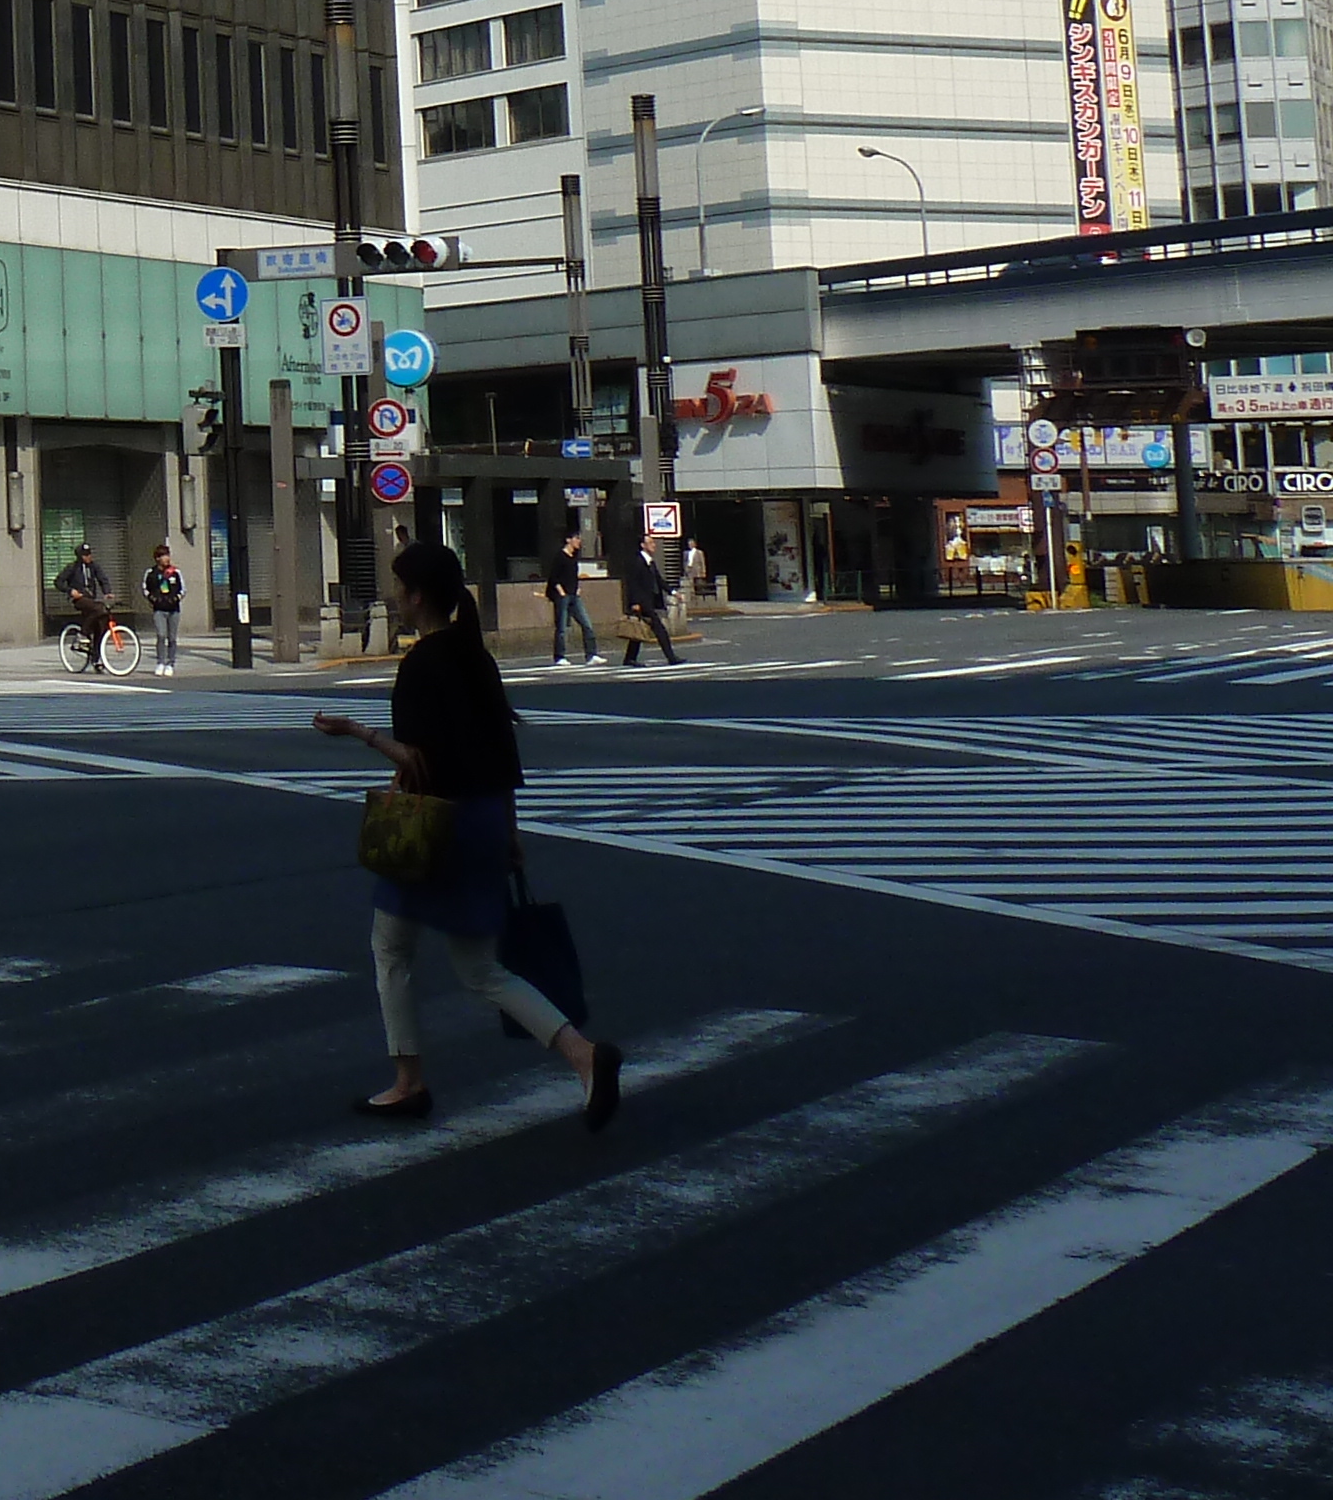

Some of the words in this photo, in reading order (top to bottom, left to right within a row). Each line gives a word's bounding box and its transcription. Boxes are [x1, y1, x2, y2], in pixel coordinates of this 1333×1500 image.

[1069, 23, 1106, 219] ジンギスカンガーデン
[1224, 474, 1264, 493] CIRO
